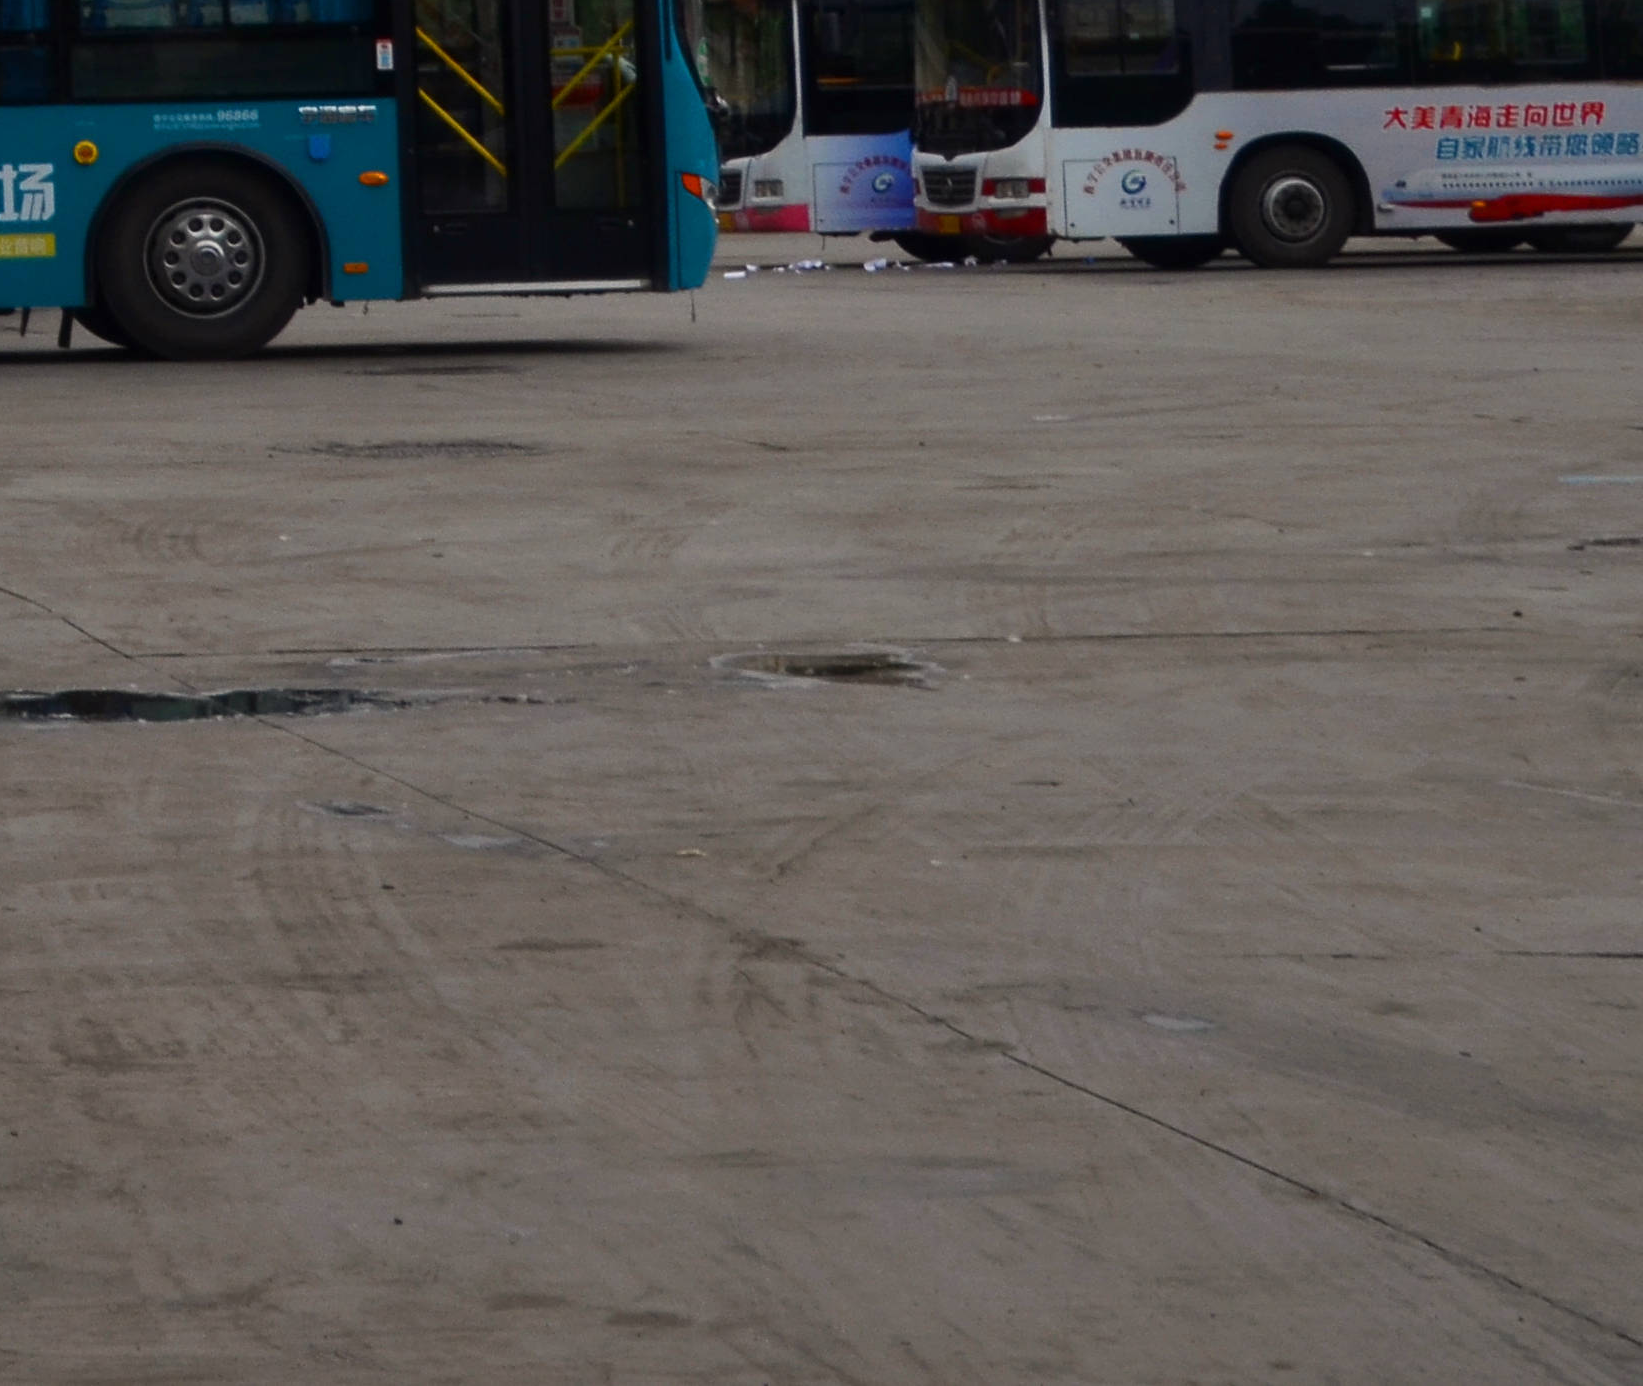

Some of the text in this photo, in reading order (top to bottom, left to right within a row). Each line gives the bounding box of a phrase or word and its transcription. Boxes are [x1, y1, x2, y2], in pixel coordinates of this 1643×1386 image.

[1383, 102, 1605, 130] 大美青海走向世界
